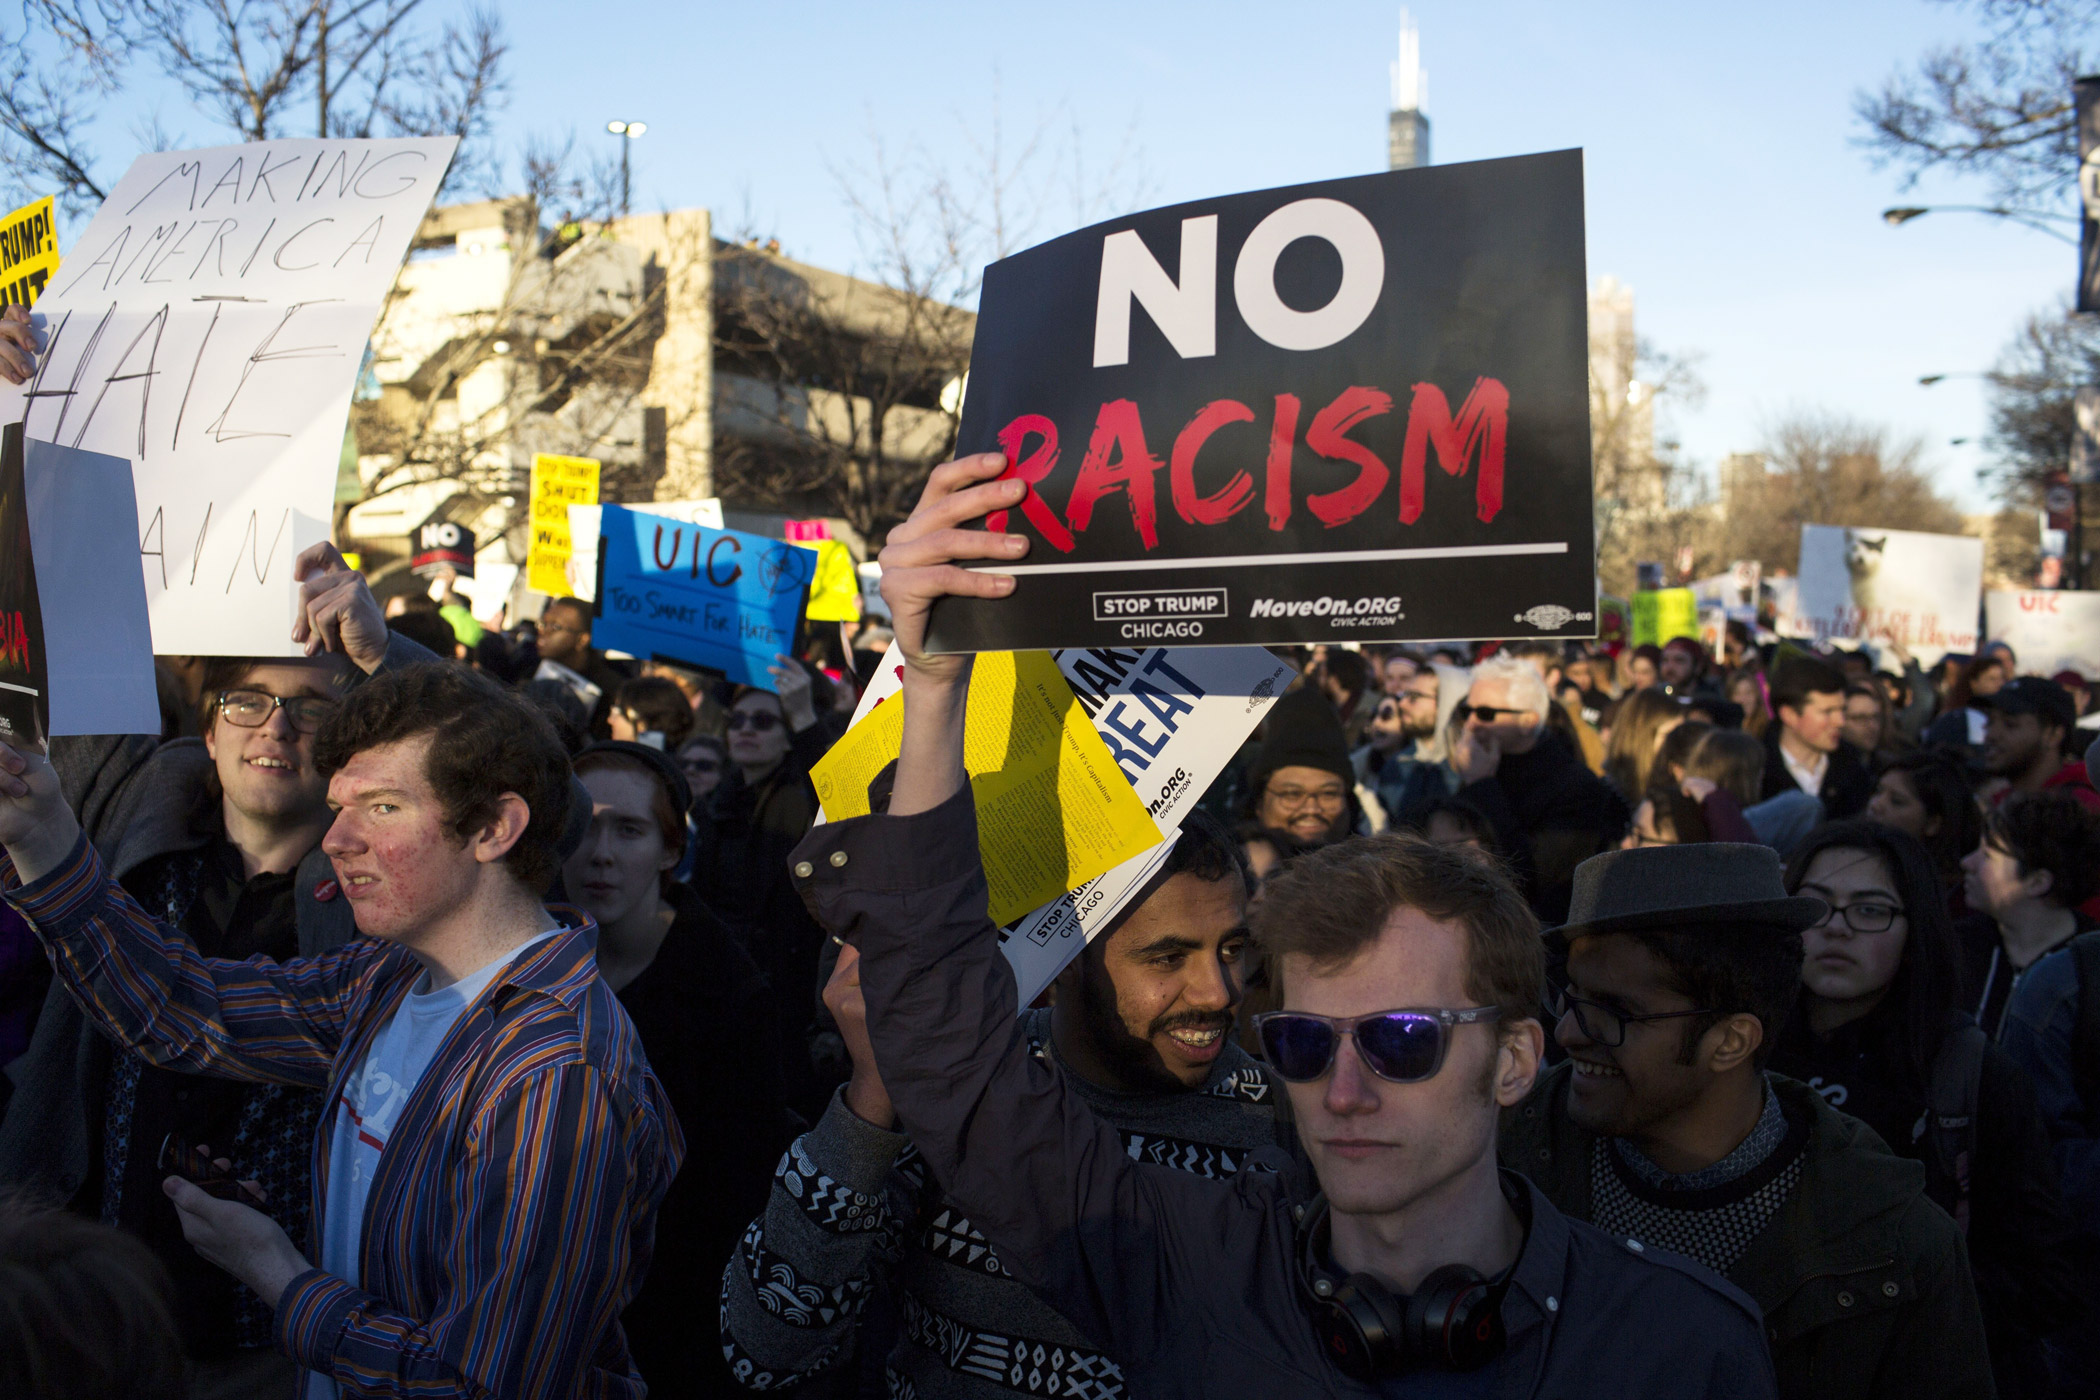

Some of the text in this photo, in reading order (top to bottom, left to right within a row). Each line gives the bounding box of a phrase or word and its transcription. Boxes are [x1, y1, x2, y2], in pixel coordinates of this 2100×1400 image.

[126, 150, 426, 215] MAKING
[0, 206, 52, 276] RUMP!
[59, 215, 383, 297] AMERICA
[1093, 197, 1385, 367] NO
[23, 296, 345, 460] HATE
[984, 376, 1509, 553] RACISM
[421, 523, 461, 549] NO
[654, 524, 742, 587] UIC
[1104, 596, 1218, 614] STOP TRUMP
[1121, 621, 1203, 638] CHICAGO
[1250, 597, 1401, 618] MoveOn.ORG
[1330, 618, 1357, 627] CIVIC
[1043, 695, 1055, 710] not
[1050, 708, 1065, 726] just
[1059, 724, 1082, 754] Trump,
[1083, 763, 1114, 804] Capitalism
[1160, 801, 1173, 819] CIVIC
[1037, 909, 1063, 938] STOP
[1060, 891, 1104, 938] CHICAGO
